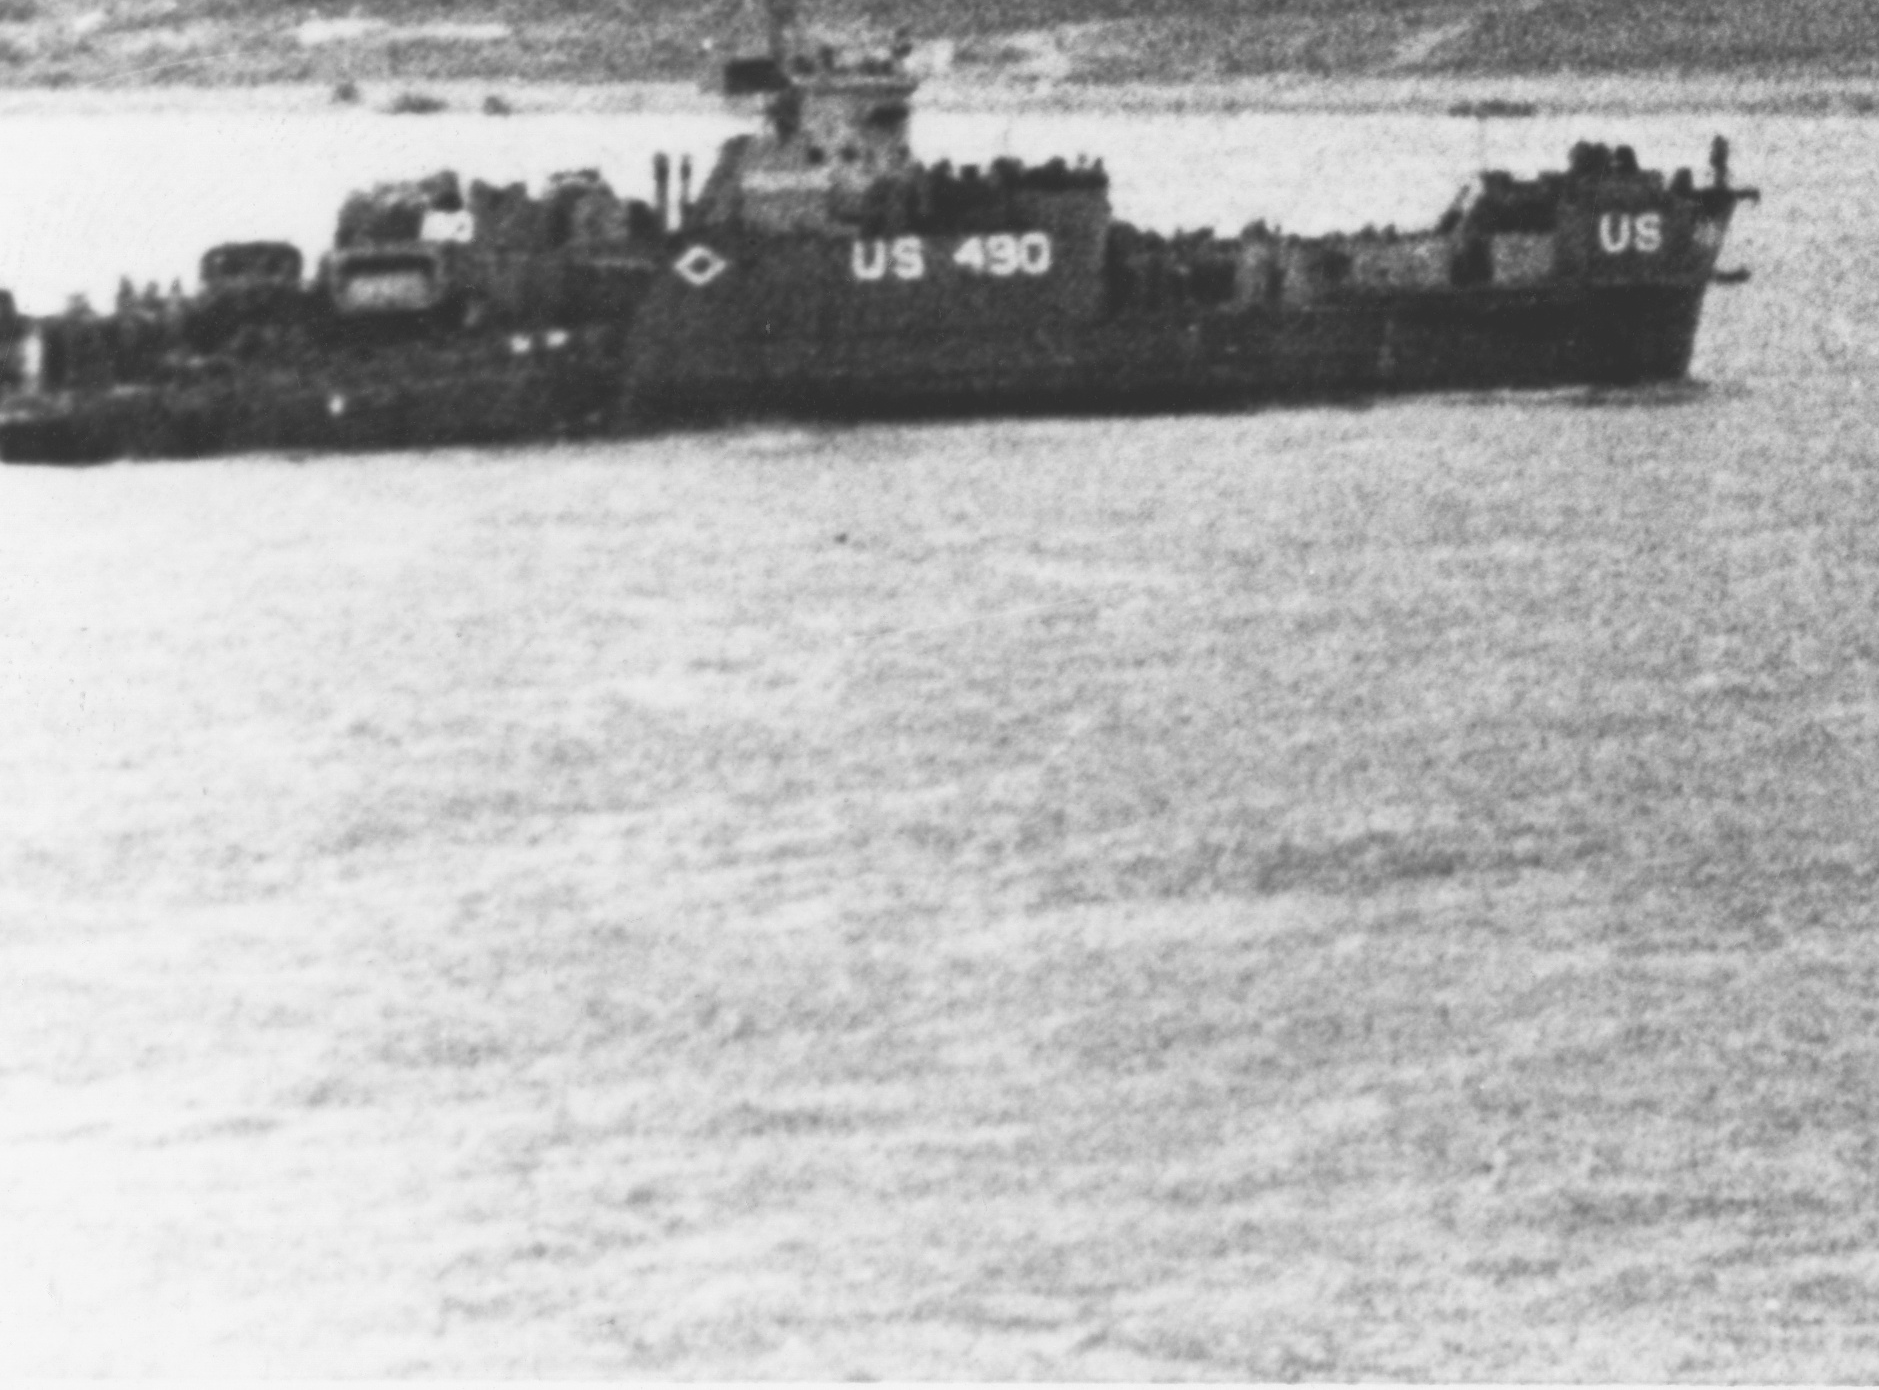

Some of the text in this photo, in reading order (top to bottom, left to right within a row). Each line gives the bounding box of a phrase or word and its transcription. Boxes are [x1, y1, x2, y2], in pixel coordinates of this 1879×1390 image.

[1599, 213, 1662, 253] US
[852, 231, 1052, 280] US 490
